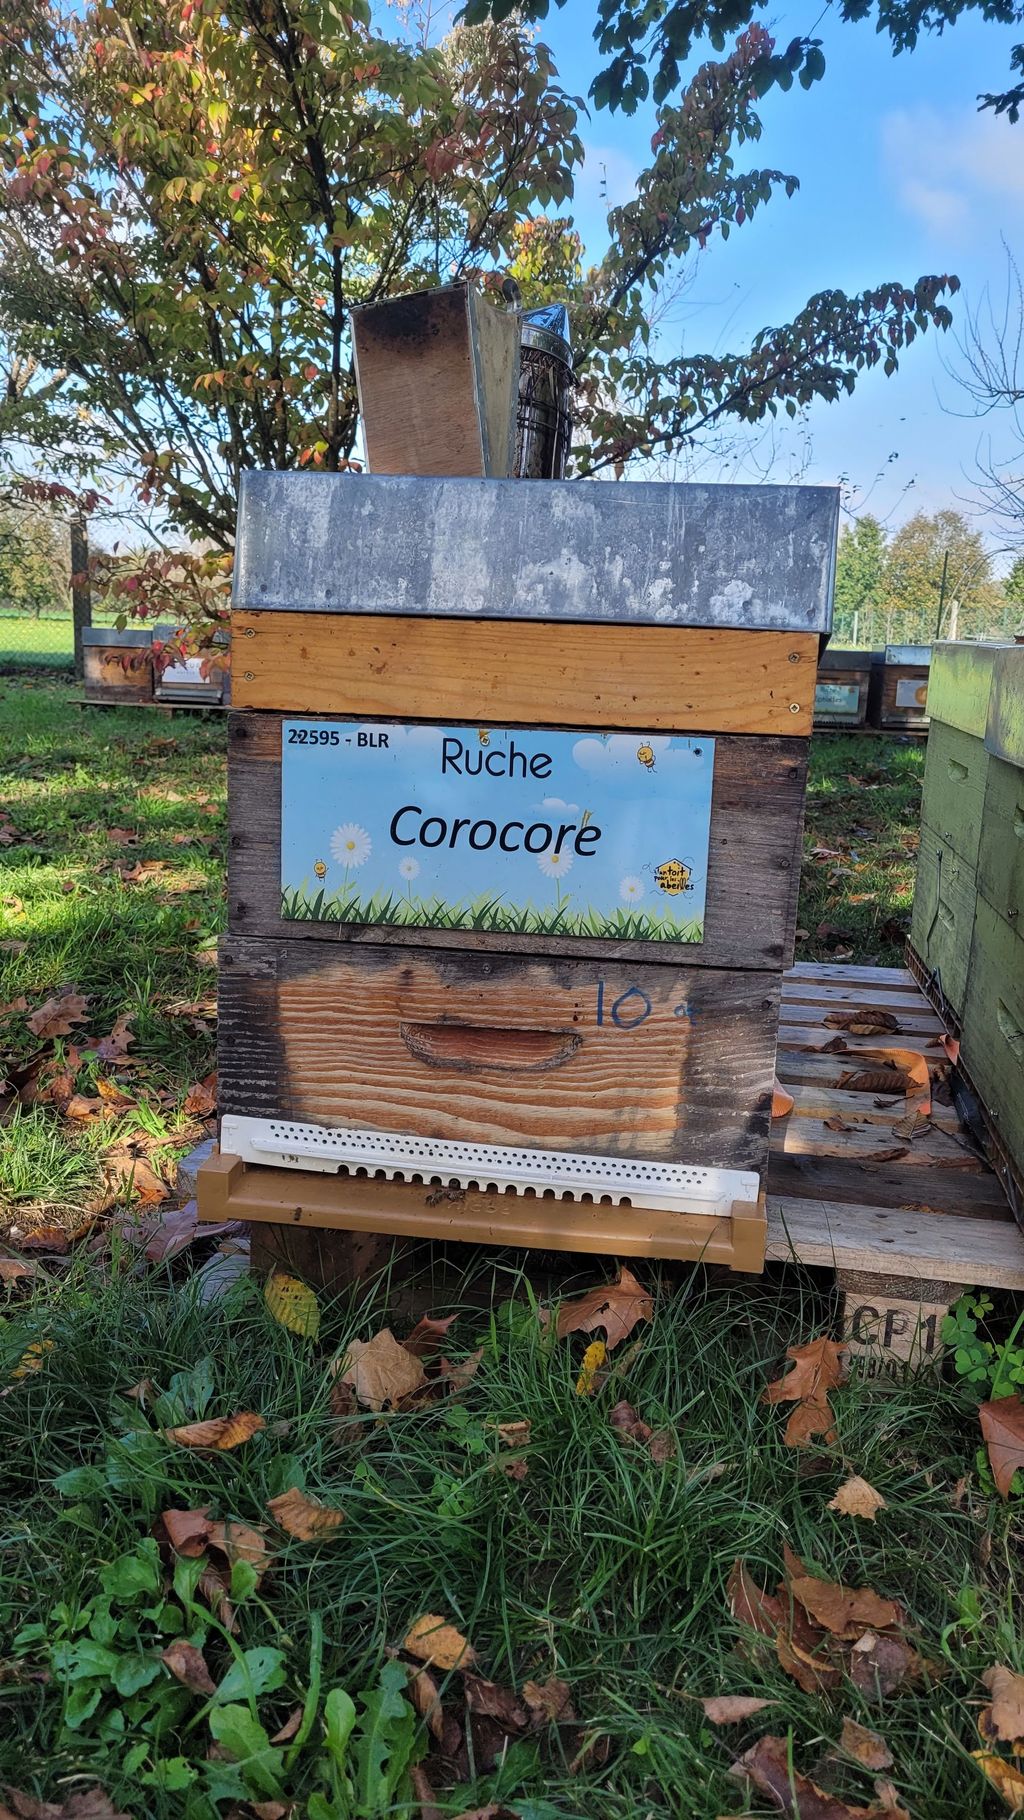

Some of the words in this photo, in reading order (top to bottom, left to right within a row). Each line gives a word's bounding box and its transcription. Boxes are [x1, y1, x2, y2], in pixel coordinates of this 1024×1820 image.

[288, 728, 340, 746] 22595
[357, 732, 389, 748] BLR
[441, 737, 553, 779] Ruche
[390, 805, 602, 857] Corocore
[660, 877, 694, 890] abeilles
[667, 865, 685, 876] toit
[596, 980, 652, 1030] 10
